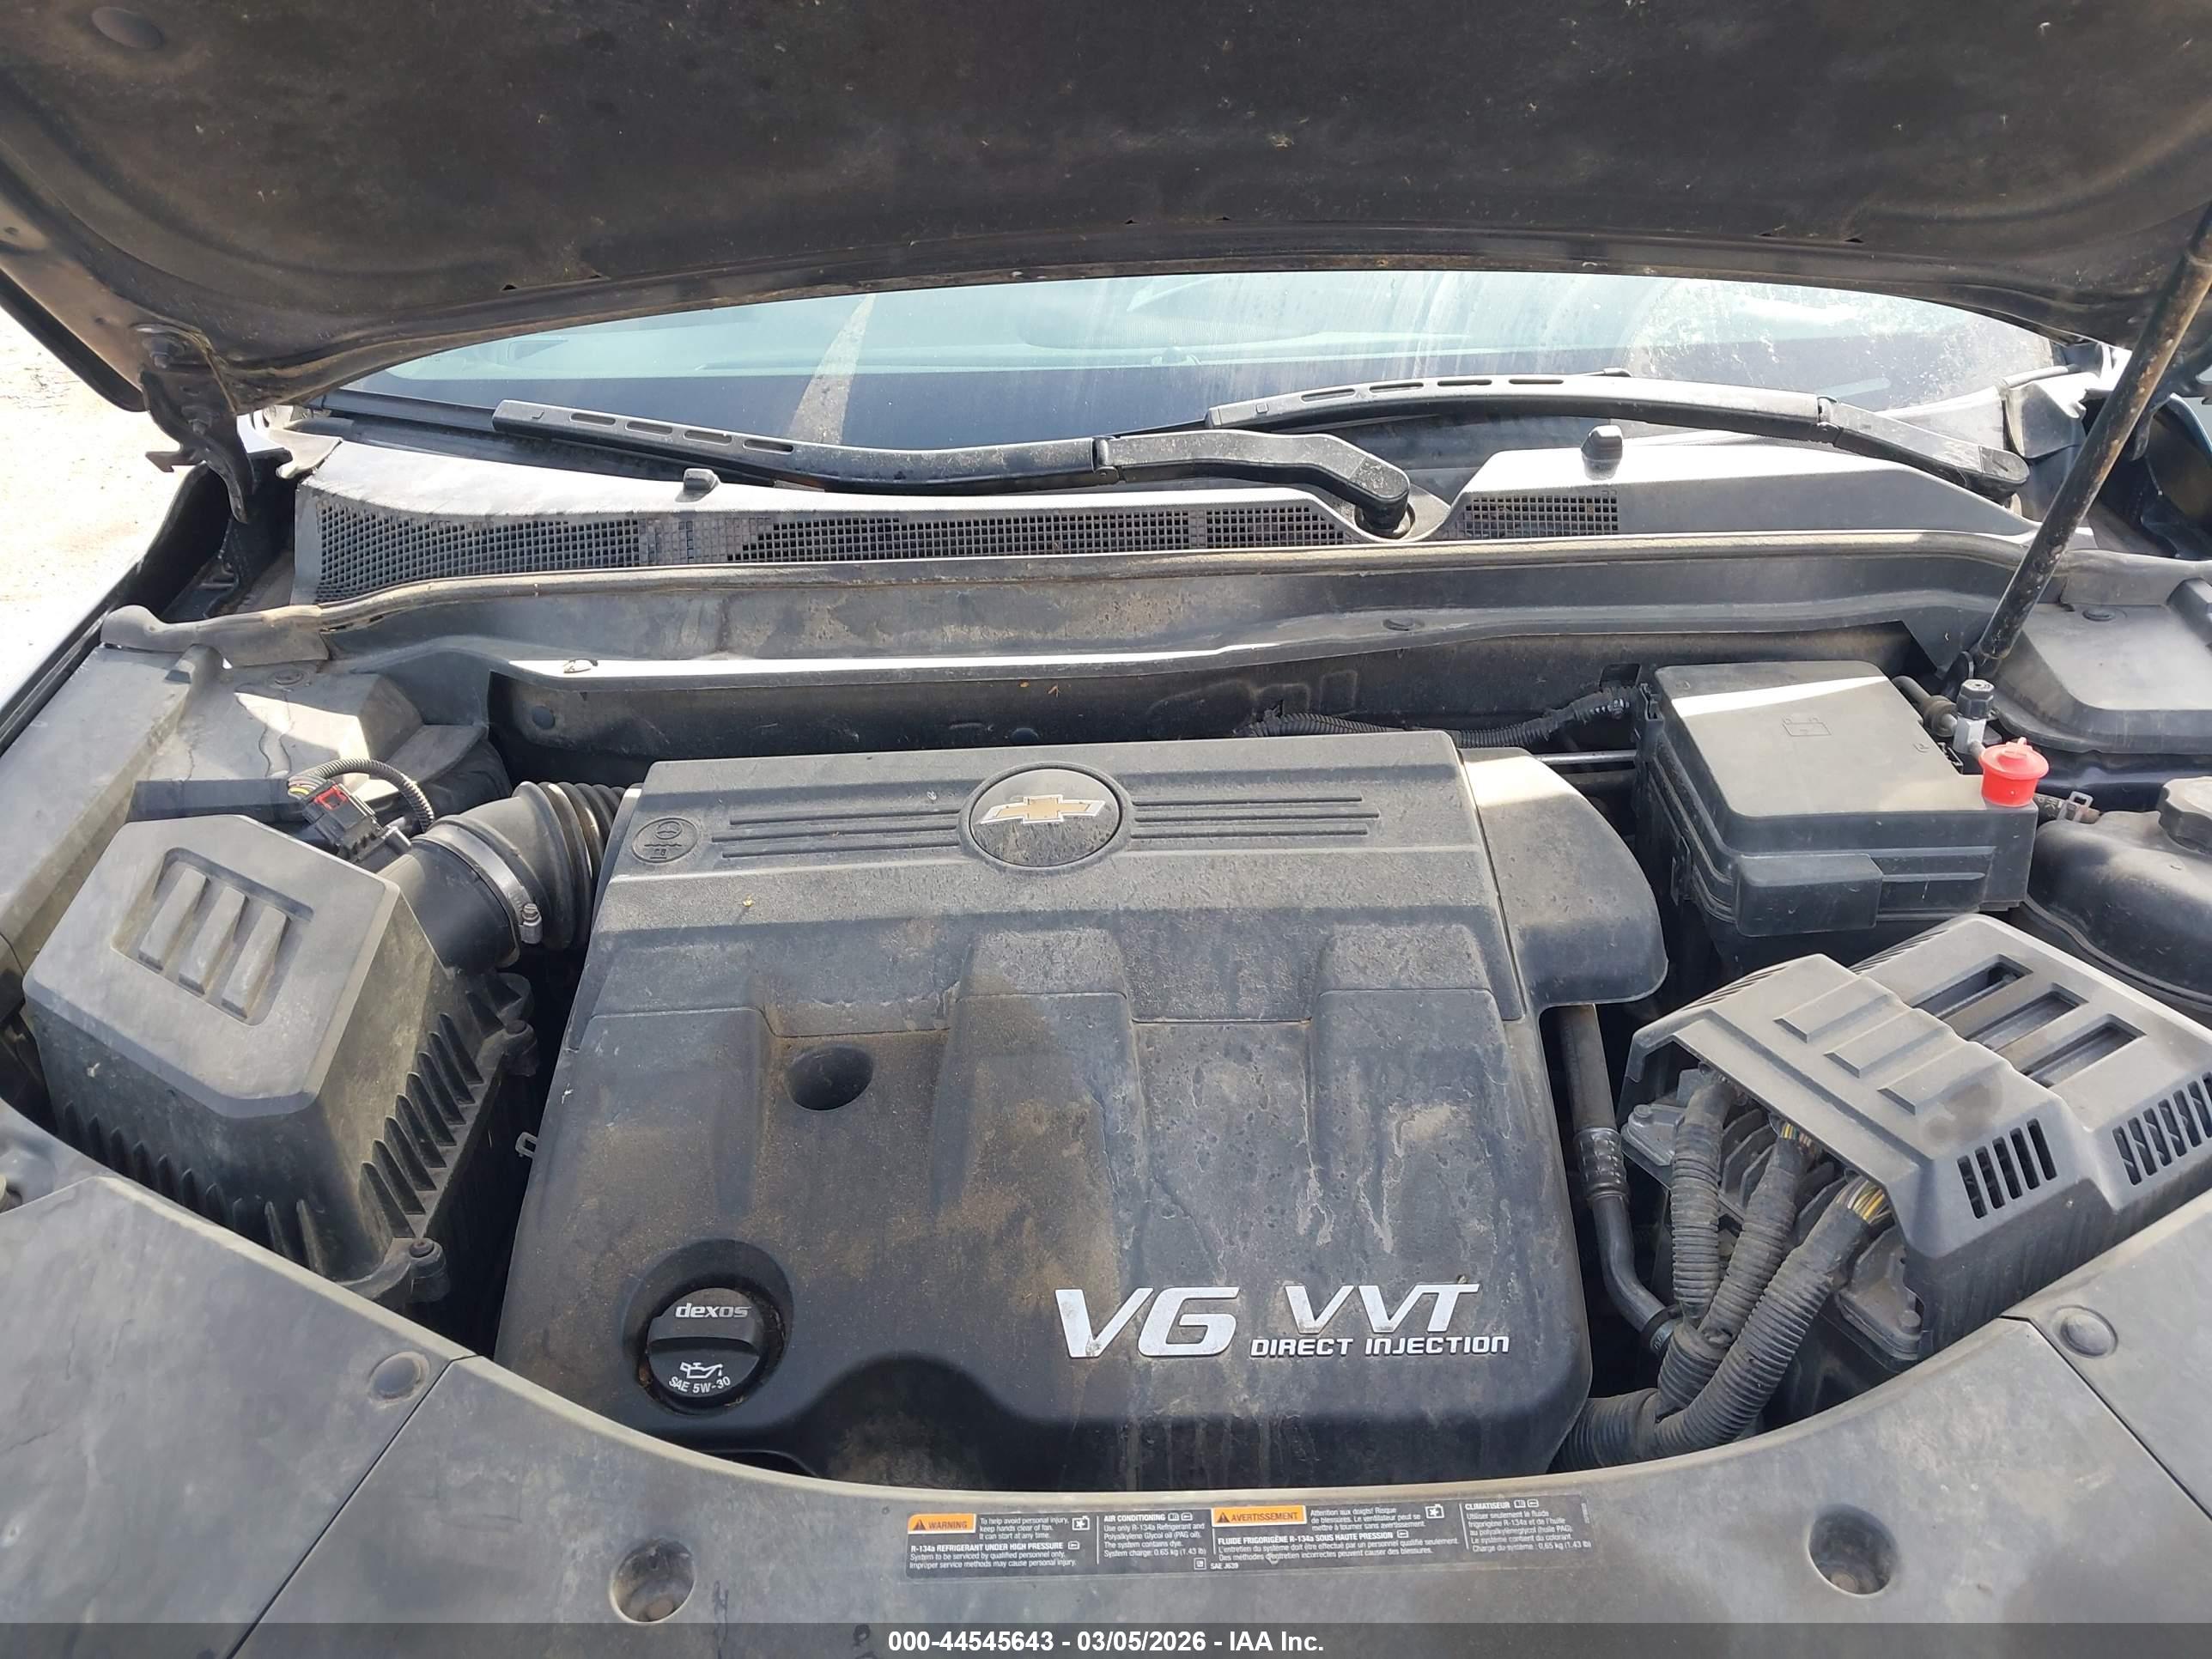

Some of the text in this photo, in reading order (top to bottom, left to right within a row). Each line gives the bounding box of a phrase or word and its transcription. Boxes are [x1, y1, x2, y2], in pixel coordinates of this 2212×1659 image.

[676, 1303, 751, 1318] dexos
[1055, 1284, 1480, 1358] V6 VVT
[1250, 1335, 1510, 1358] DIRECT INJECTION
[669, 1376, 731, 1394] SAE 5W-30
[1231, 1512, 1298, 1522] AVERTISSEMENT
[928, 1521, 967, 1529] WARNING
[1157, 1523, 1188, 1532] Refrigerant
[1243, 1535, 1288, 1544] FRIGORIGÈNE
[1358, 1532, 1393, 1540] PRESSION
[911, 1544, 935, 1553] R-134a
[937, 1543, 983, 1552] REFRIGERANT
[1170, 1548, 1178, 1557] kg
[910, 1553, 933, 1562] System
[909, 1561, 938, 1570] Improper
